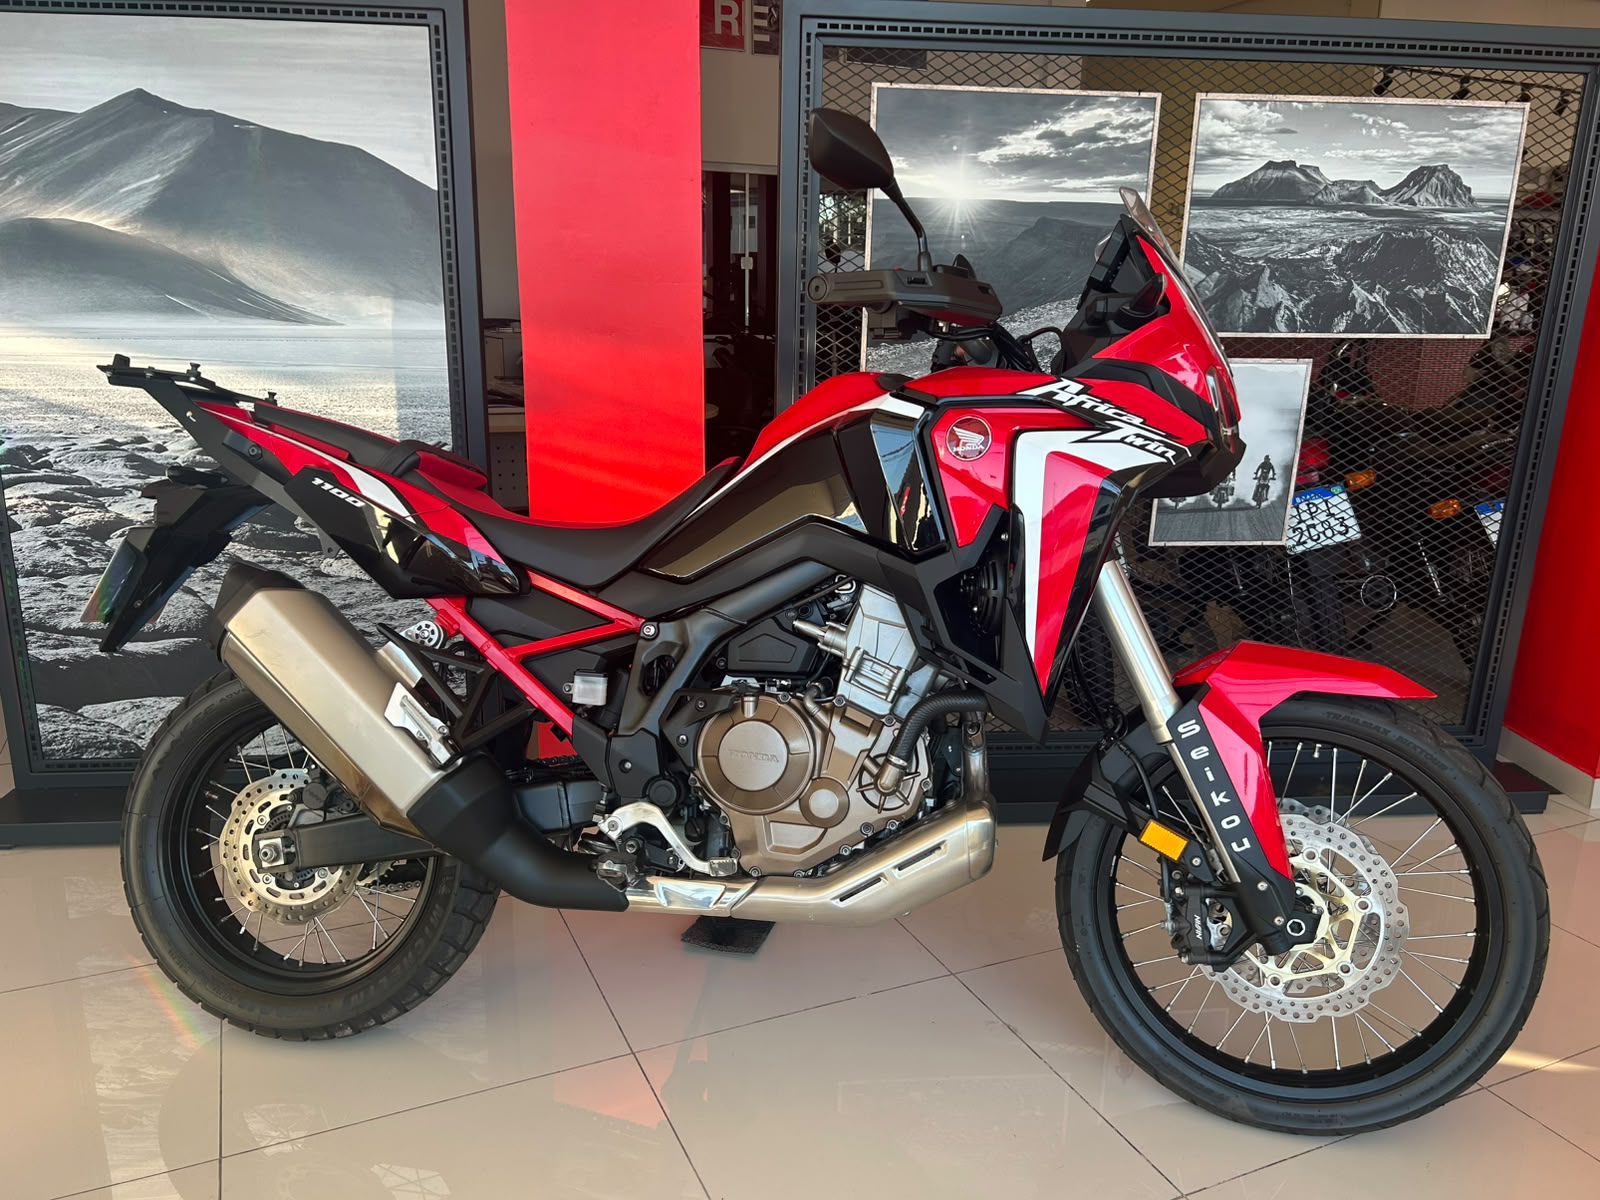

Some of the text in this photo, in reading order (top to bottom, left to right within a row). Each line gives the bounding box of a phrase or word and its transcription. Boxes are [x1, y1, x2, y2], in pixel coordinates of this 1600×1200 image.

[1016, 377, 1146, 426] Africa
[952, 444, 985, 452] HONDA
[1088, 420, 1192, 465] Twin
[311, 477, 366, 507] 1100
[1325, 711, 1392, 736] TRAILMAX
[727, 748, 780, 763] HONDA
